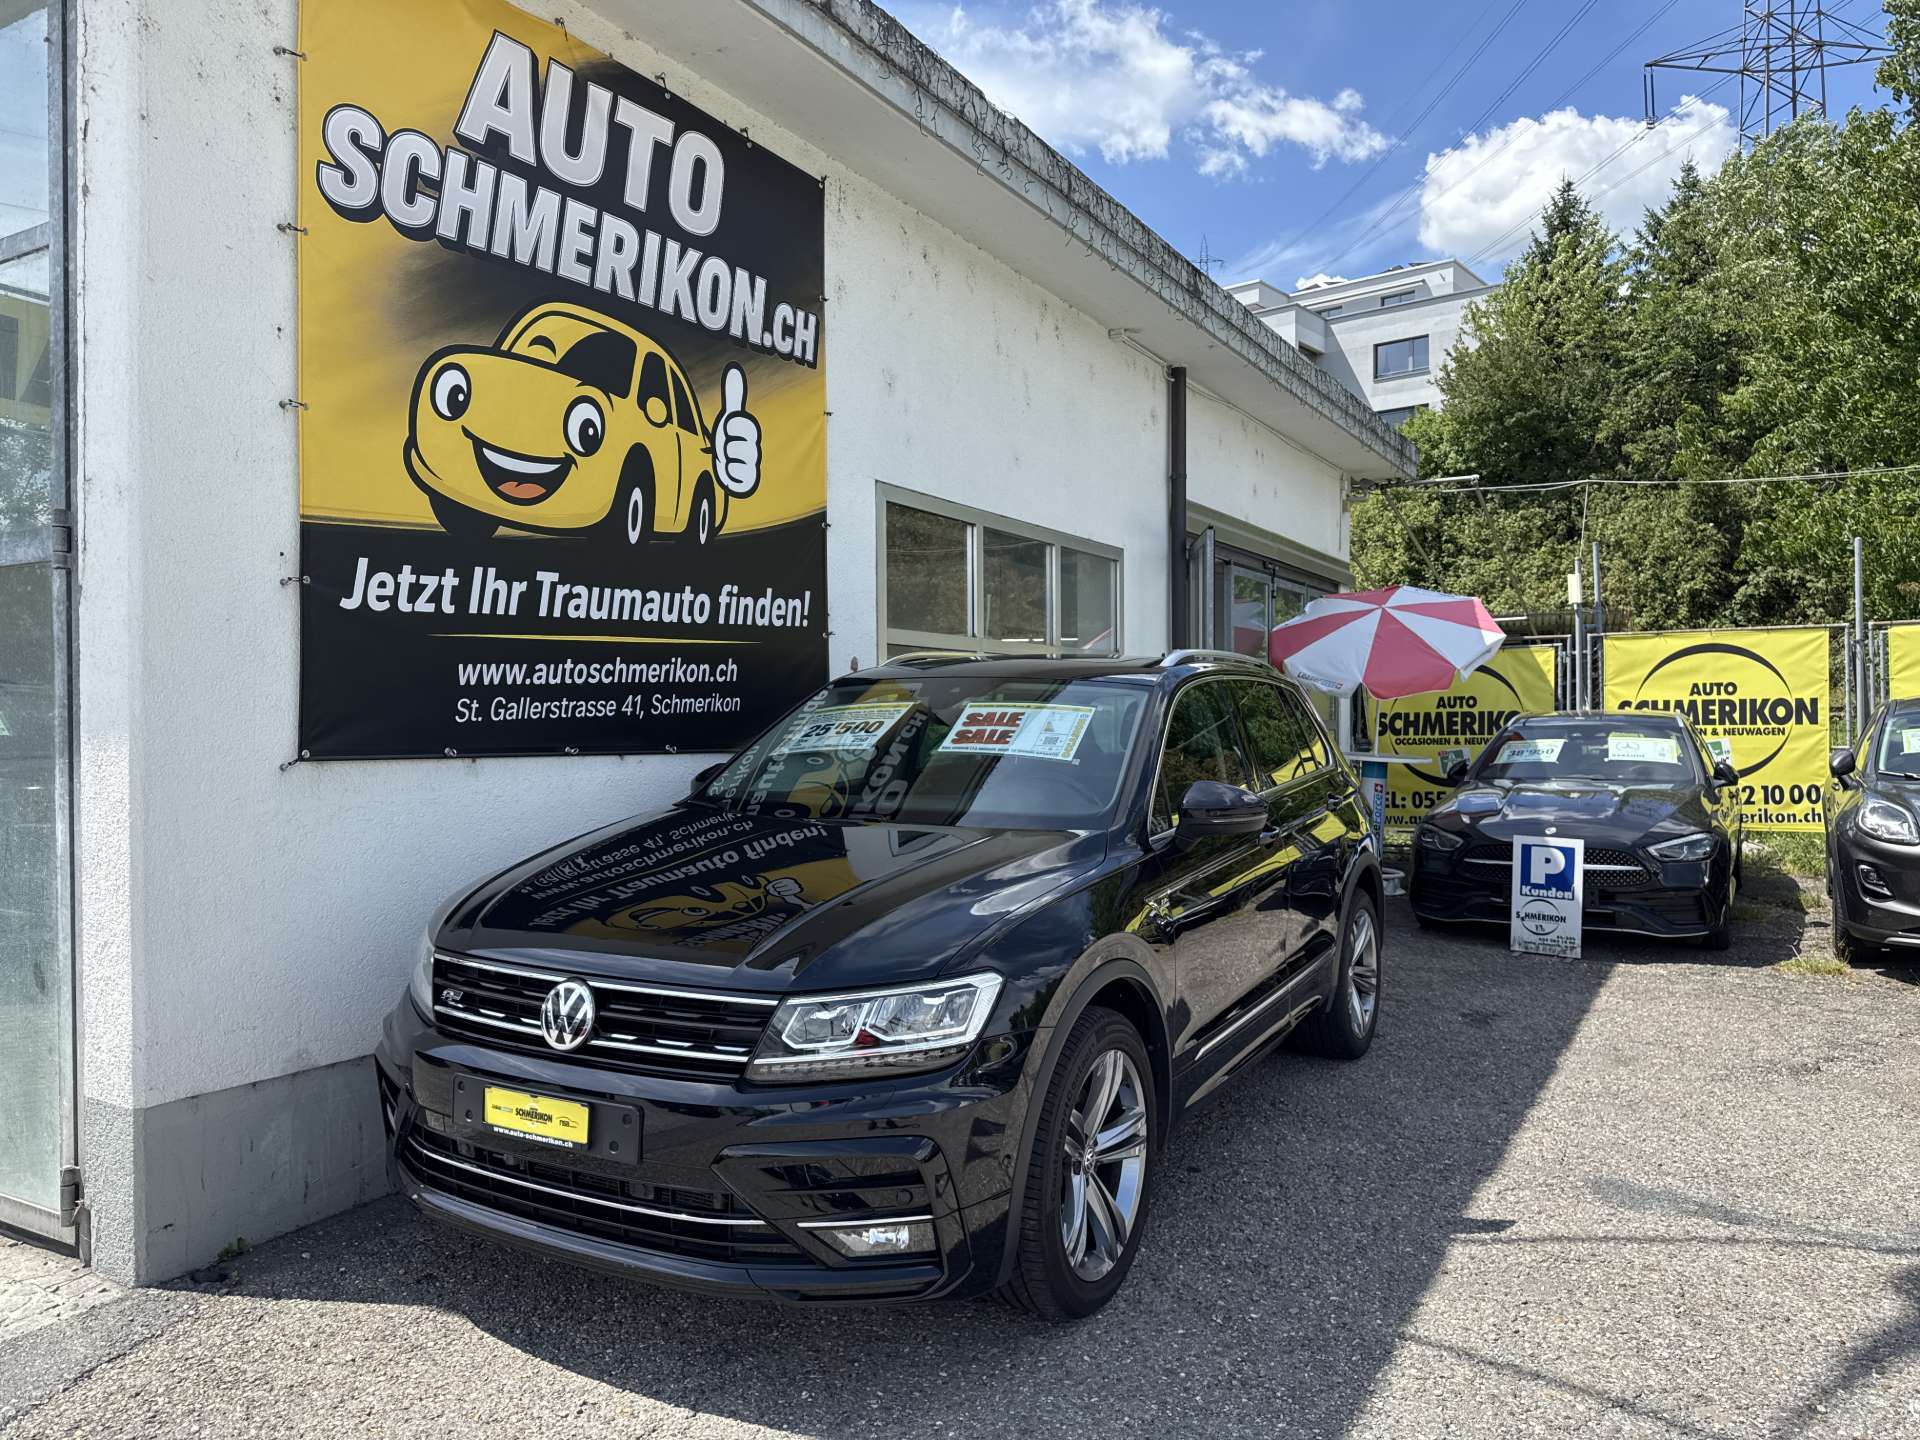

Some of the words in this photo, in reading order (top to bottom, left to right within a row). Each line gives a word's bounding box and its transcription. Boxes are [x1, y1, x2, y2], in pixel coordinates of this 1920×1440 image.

[455, 32, 725, 237] AUTO
[318, 106, 819, 362] SCHMERIKON.CH
[340, 557, 460, 614] Jetzt
[468, 566, 527, 616] Ihr
[535, 571, 710, 625] Traumauto
[718, 585, 811, 627] finden!
[457, 657, 738, 686] www.autoschmerikon.ch
[1689, 682, 1738, 696] AUTO
[455, 698, 482, 723] St.
[490, 694, 617, 722] Gallerstrasse
[620, 695, 644, 720] 41,
[651, 694, 741, 714] Schmerikon
[1436, 696, 1477, 709] AUTO
[962, 711, 1025, 727] SALE
[801, 720, 885, 738] 25'500
[951, 729, 1017, 745] SALE
[1711, 727, 1720, 736] &
[1723, 727, 1786, 736] NEUWAGEN
[1395, 738, 1450, 746] OCCASIONEN
[1454, 738, 1461, 746] &
[1761, 784, 1785, 805] 10
[1789, 783, 1821, 805] 00
[1530, 846, 1566, 884] P
[1521, 884, 1575, 899] Kunden
[515, 1107, 553, 1123] SCHMERIKON
